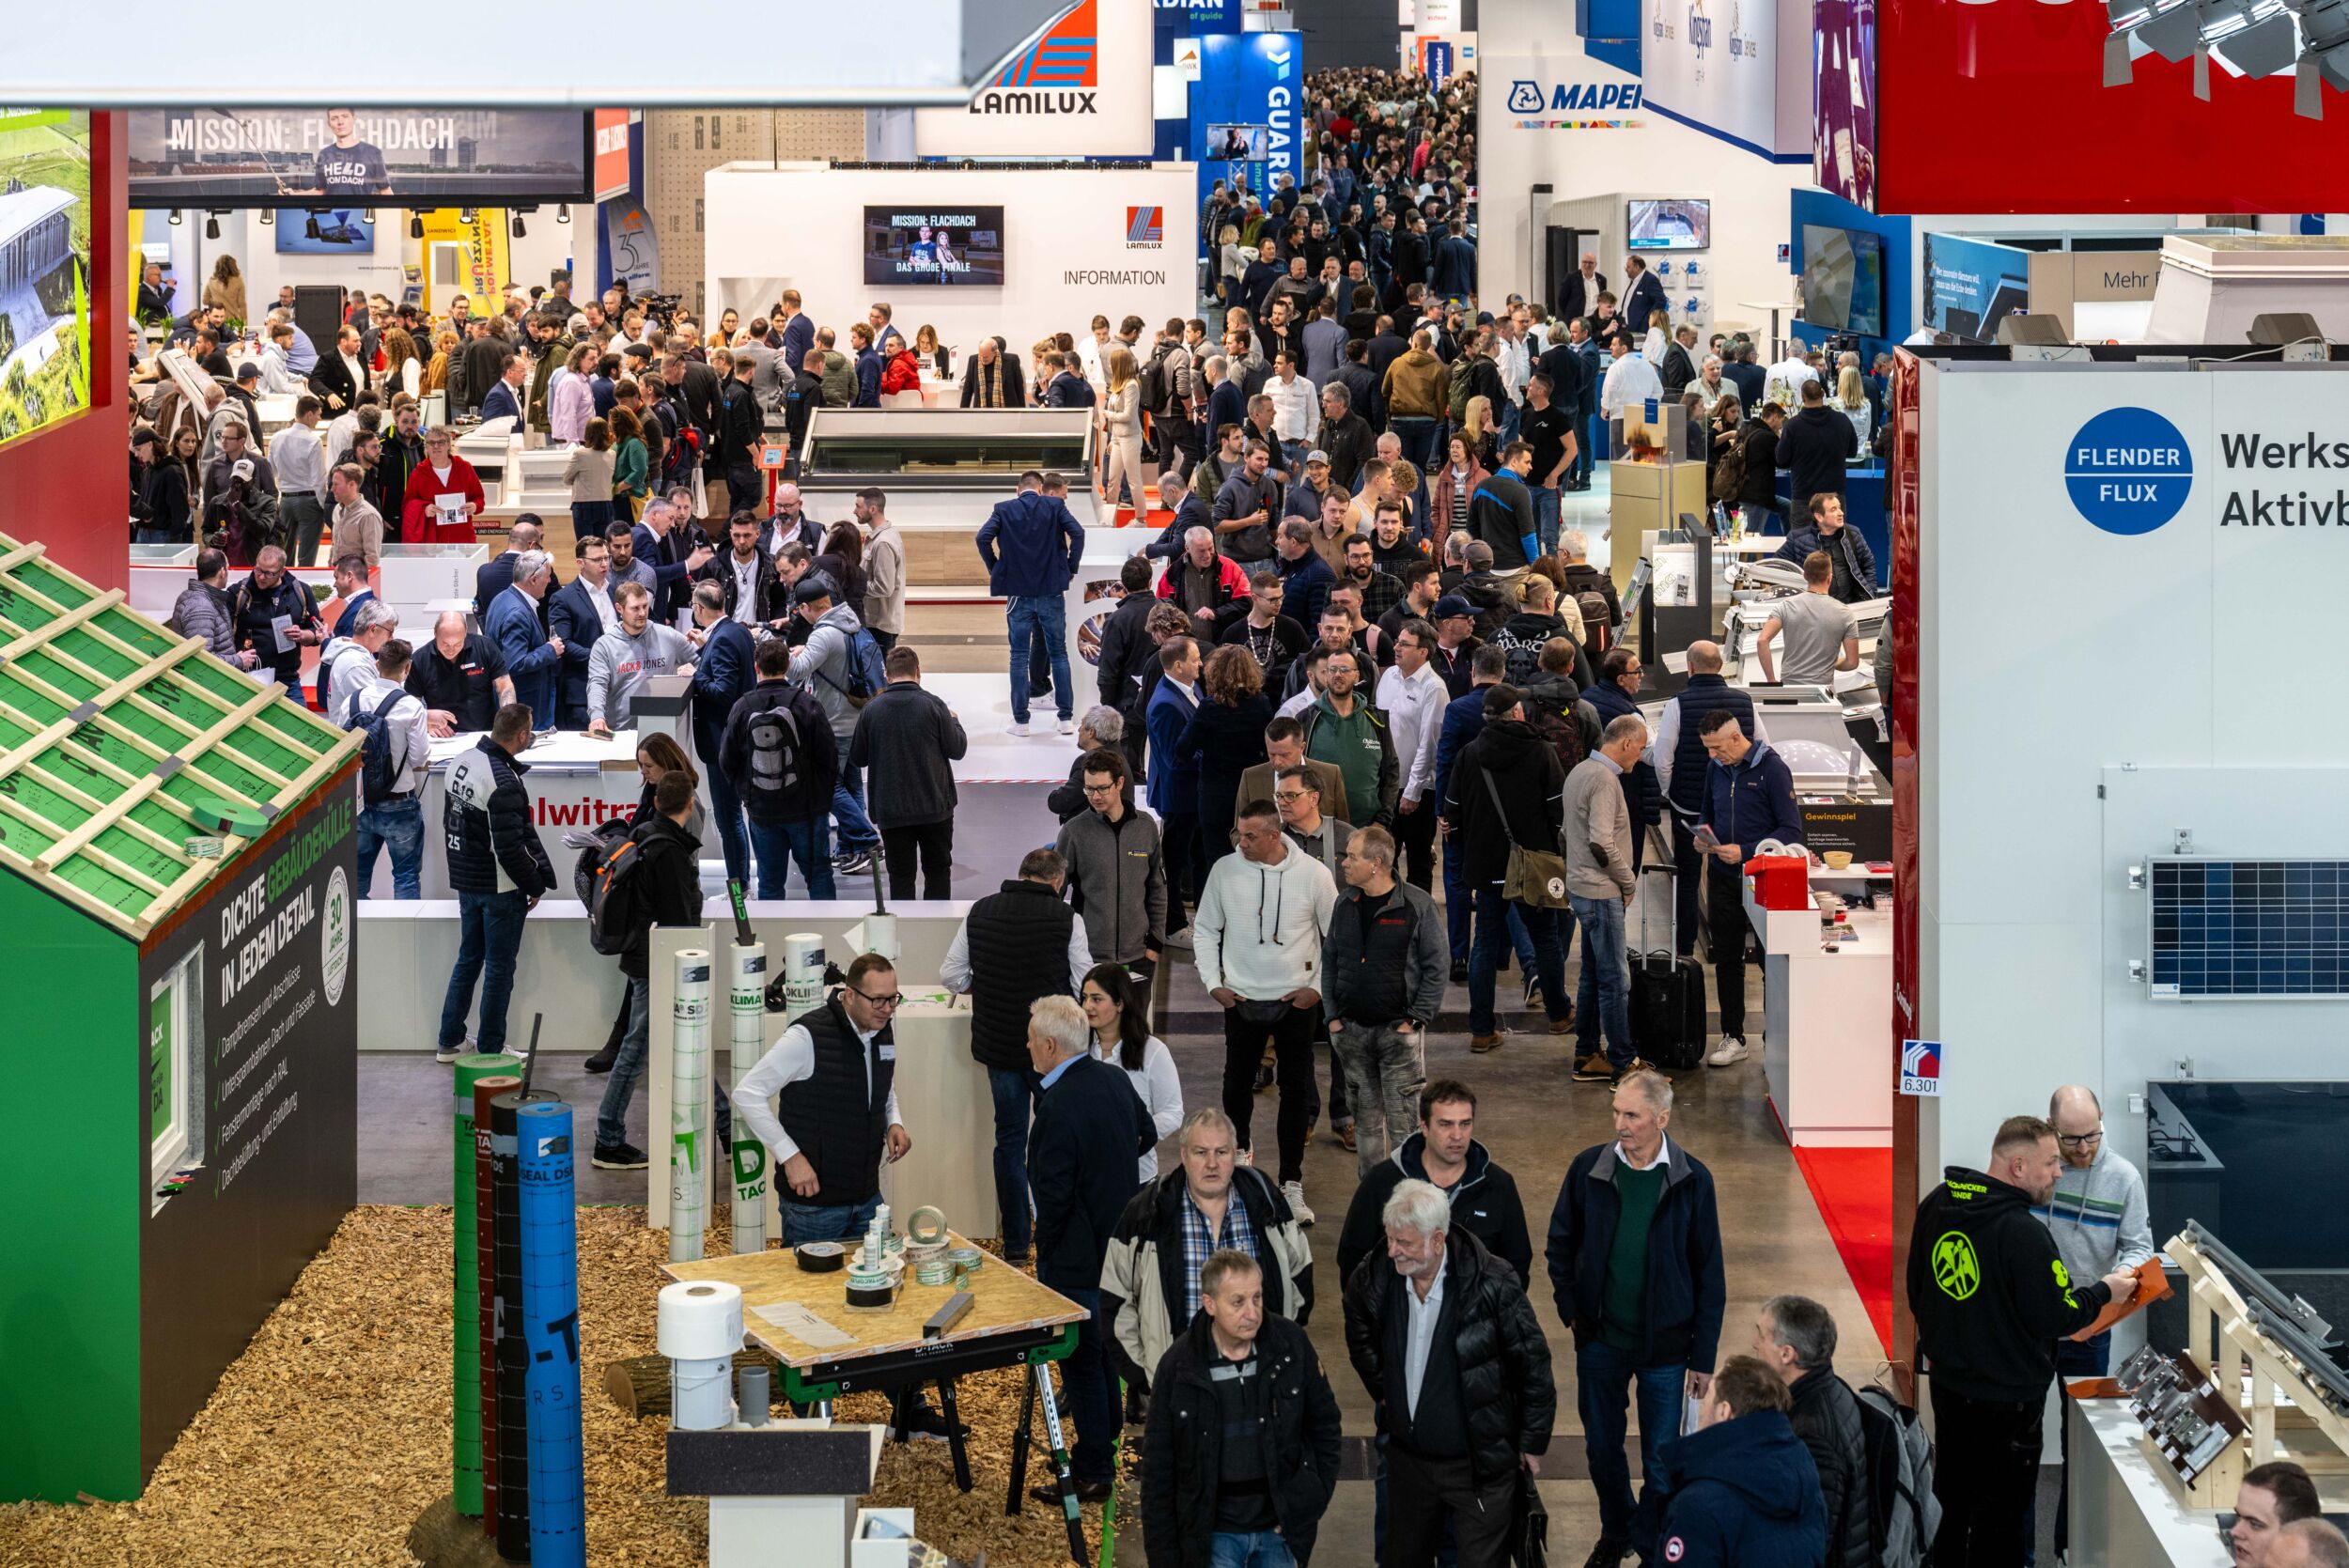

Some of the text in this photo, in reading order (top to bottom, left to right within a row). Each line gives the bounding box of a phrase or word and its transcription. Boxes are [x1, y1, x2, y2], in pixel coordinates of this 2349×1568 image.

[1190, 12, 1223, 22] of guide
[171, 118, 290, 149] MISSION:
[303, 118, 455, 150] FLCHDACH
[341, 176, 365, 186] DACH
[892, 215, 976, 227] MISSION: FLACHDACH
[614, 231, 645, 272] 35
[896, 262, 912, 272] DAS
[942, 262, 971, 272] FINALE
[1065, 271, 1166, 285] INFORMATION
[2104, 272, 2150, 288] Mehr
[2077, 448, 2180, 466] FLENDER
[2100, 484, 2158, 502] FLUX
[643, 658, 666, 670] JONES
[528, 797, 640, 827] lwitra
[1805, 813, 1857, 822] Gewinnspiel
[448, 834, 460, 851] 25
[222, 873, 265, 950] DICHTE
[267, 797, 351, 904] GEBÄUDEHÜLLE
[330, 893, 342, 931] 30
[730, 882, 747, 921] NEU
[222, 958, 235, 1007] IN
[237, 919, 275, 992] JEDEM
[278, 884, 315, 951] DETAIL
[329, 927, 343, 954] JAHRE
[222, 965, 301, 1058] Dampfbremsen und Anschlüsse
[222, 988, 316, 1101] Unterspannbahnen Dach und Fassade
[1904, 1078, 1937, 1093] 6.301
[222, 1057, 288, 1146] Fenstermontage nach RAL
[222, 1091, 298, 1191] Dachbelüftung- und Entlüftung
